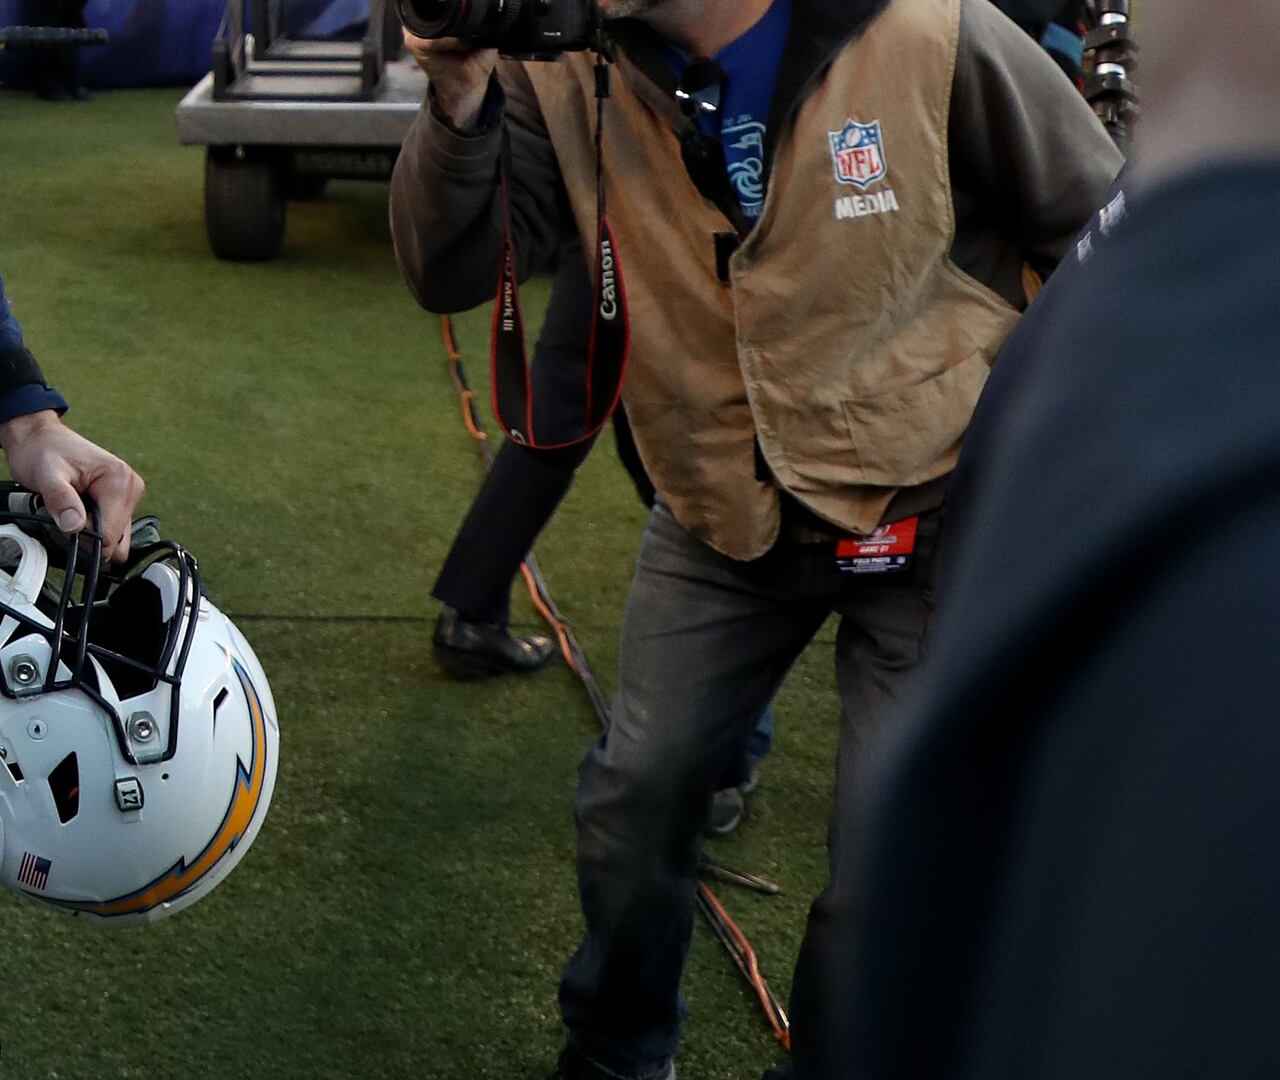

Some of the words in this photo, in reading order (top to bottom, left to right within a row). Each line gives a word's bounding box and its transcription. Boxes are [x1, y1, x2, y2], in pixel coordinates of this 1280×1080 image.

[837, 147, 881, 179] NFL
[835, 189, 900, 220] MEDIA
[600, 239, 618, 322] Canon
[502, 281, 515, 316] Mark
[122, 789, 139, 804] 17
